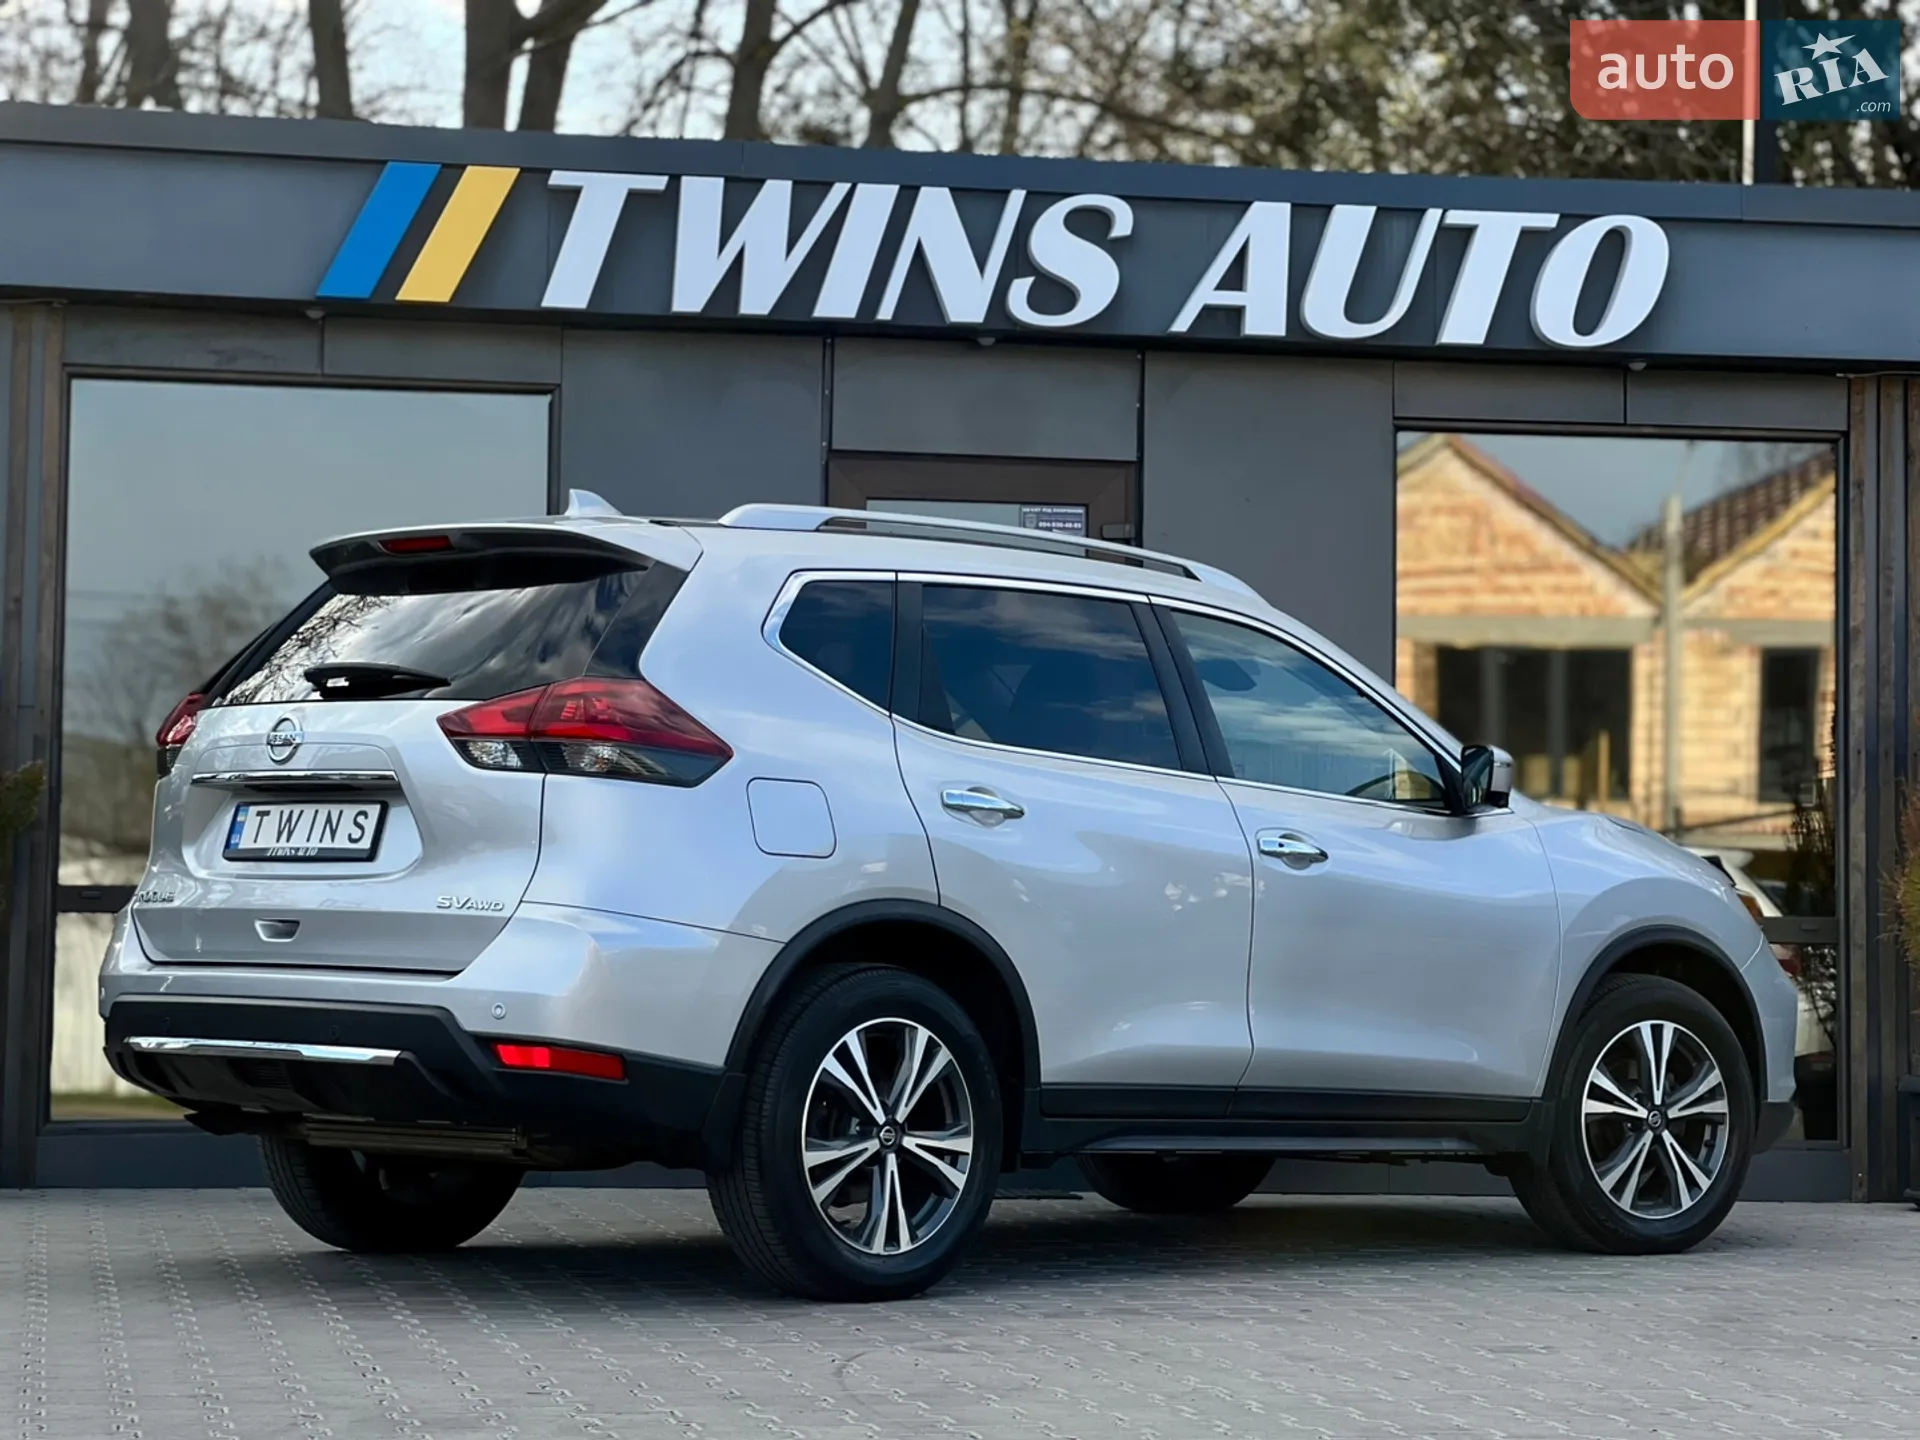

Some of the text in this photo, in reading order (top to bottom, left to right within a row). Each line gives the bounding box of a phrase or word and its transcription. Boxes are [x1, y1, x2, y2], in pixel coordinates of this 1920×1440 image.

[540, 169, 1670, 348] TWINS AUTO
[253, 809, 369, 844] TWINS
